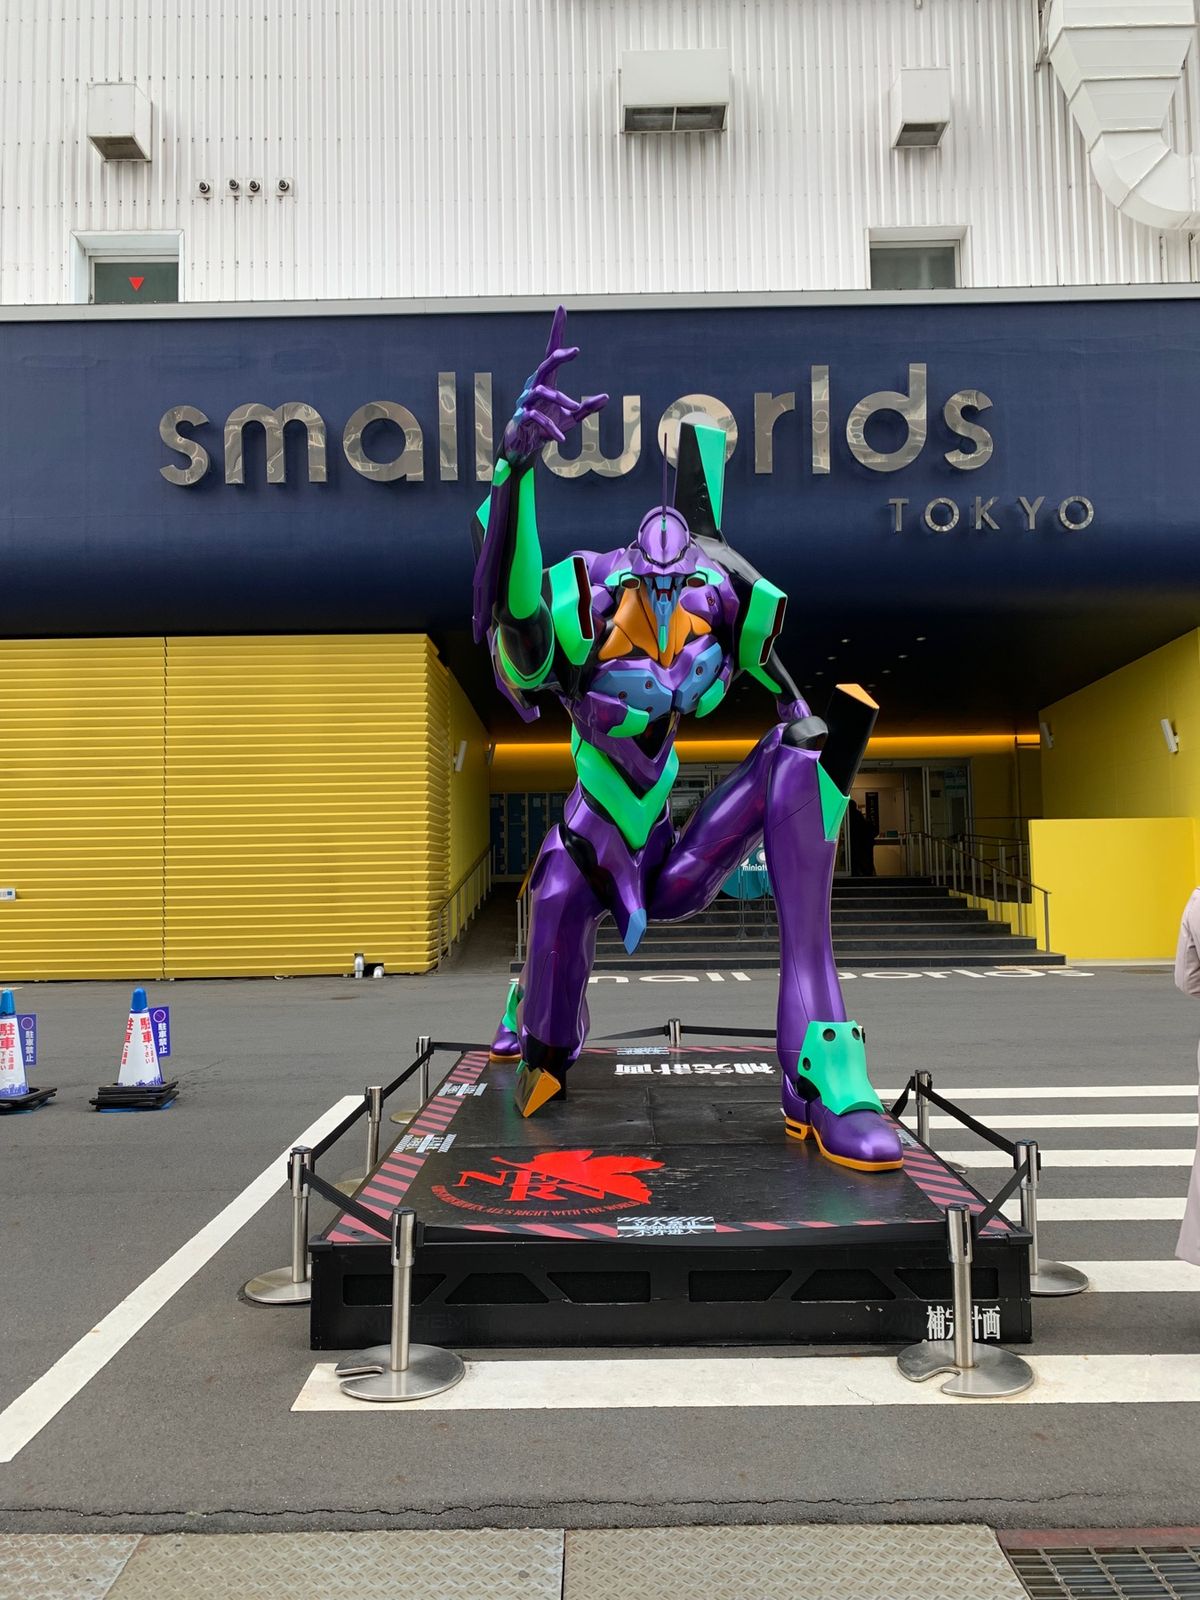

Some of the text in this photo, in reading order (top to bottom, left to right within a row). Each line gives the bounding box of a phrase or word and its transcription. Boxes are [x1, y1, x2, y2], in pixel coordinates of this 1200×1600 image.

[159, 363, 994, 486] small worlds
[888, 495, 1095, 533] TOKYO
